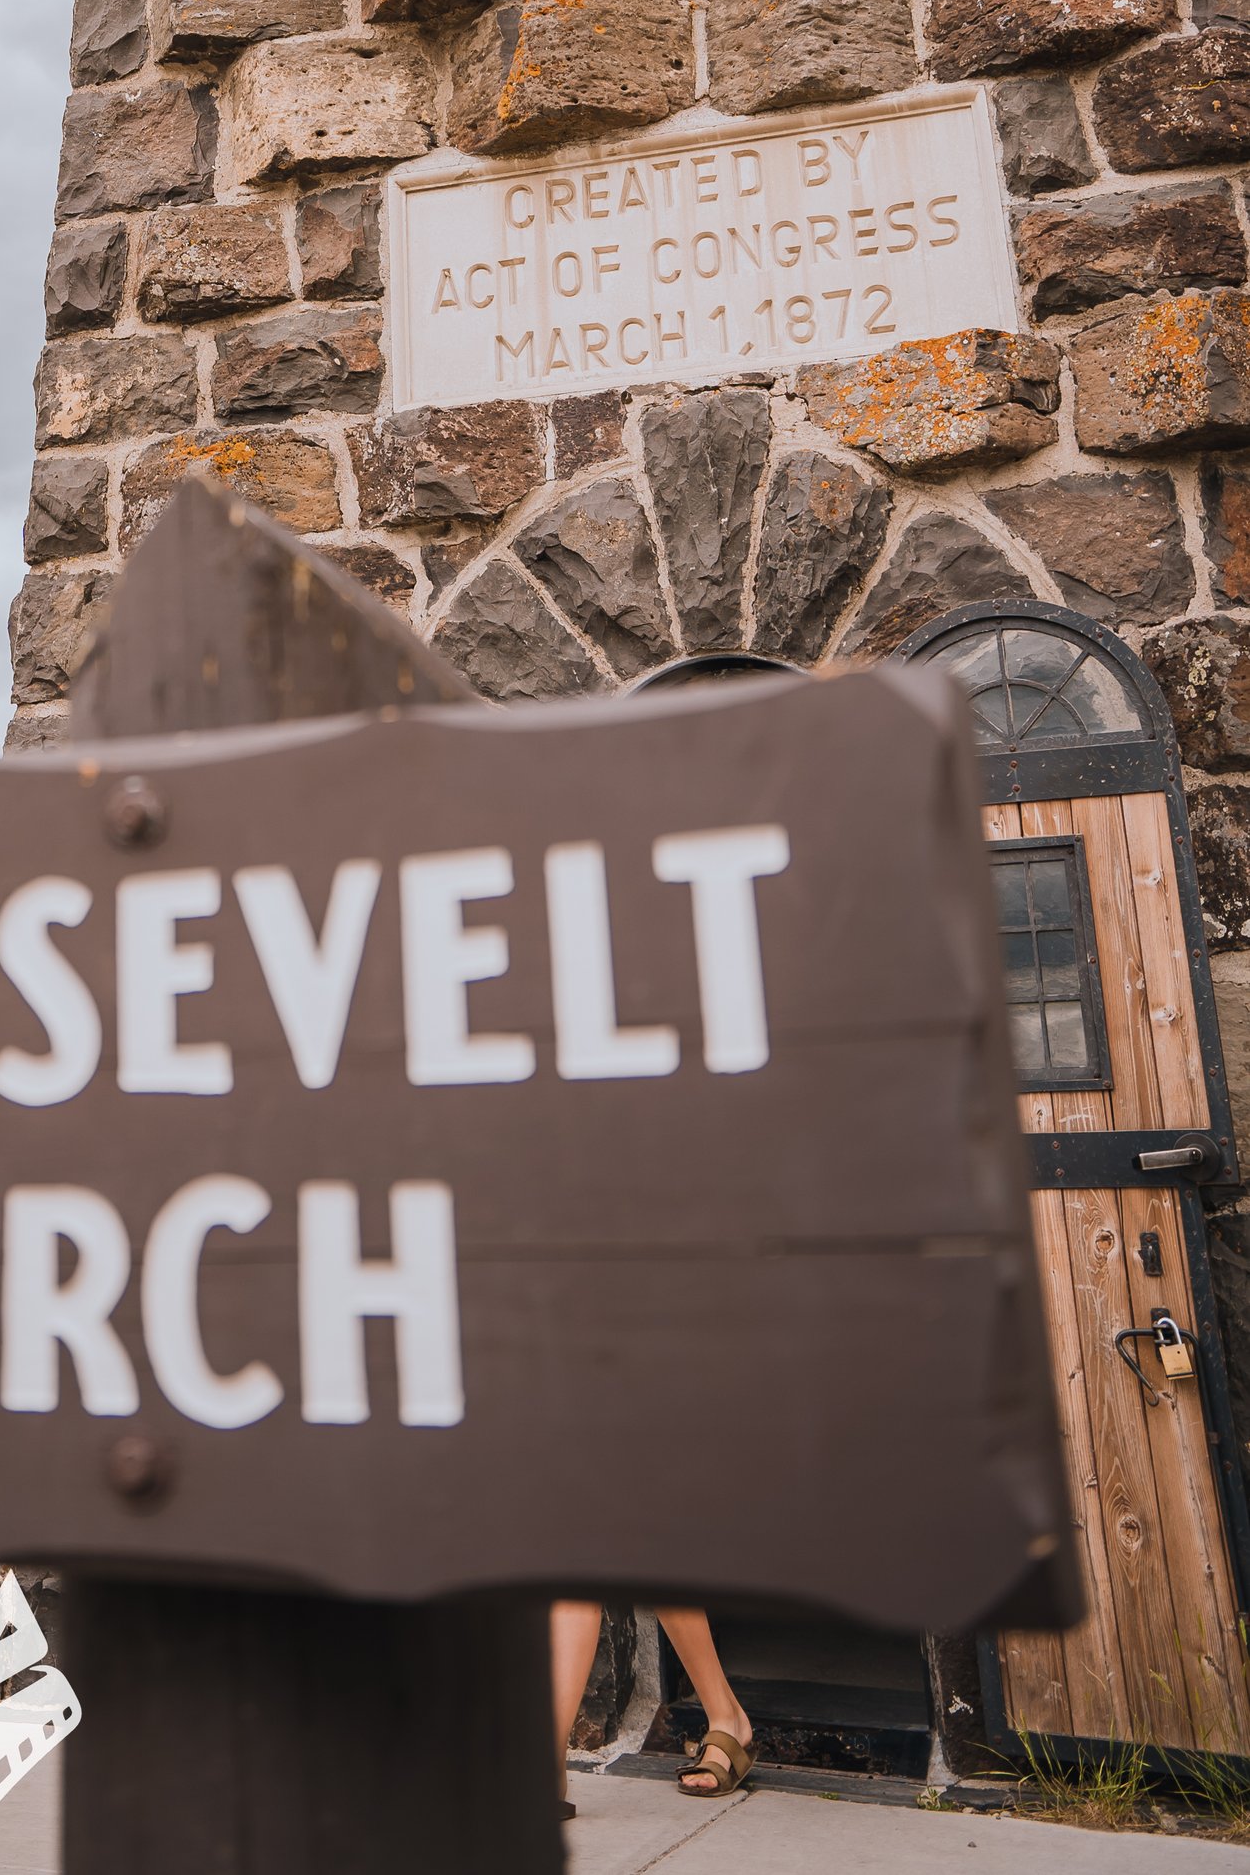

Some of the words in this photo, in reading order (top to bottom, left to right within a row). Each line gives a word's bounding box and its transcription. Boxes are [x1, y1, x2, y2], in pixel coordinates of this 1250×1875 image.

[505, 148, 762, 230] CREATED
[796, 130, 869, 188] BY
[431, 255, 526, 315] ACT
[551, 243, 622, 298] OF
[651, 194, 960, 285] CONGRESS
[493, 309, 686, 382] MARCH
